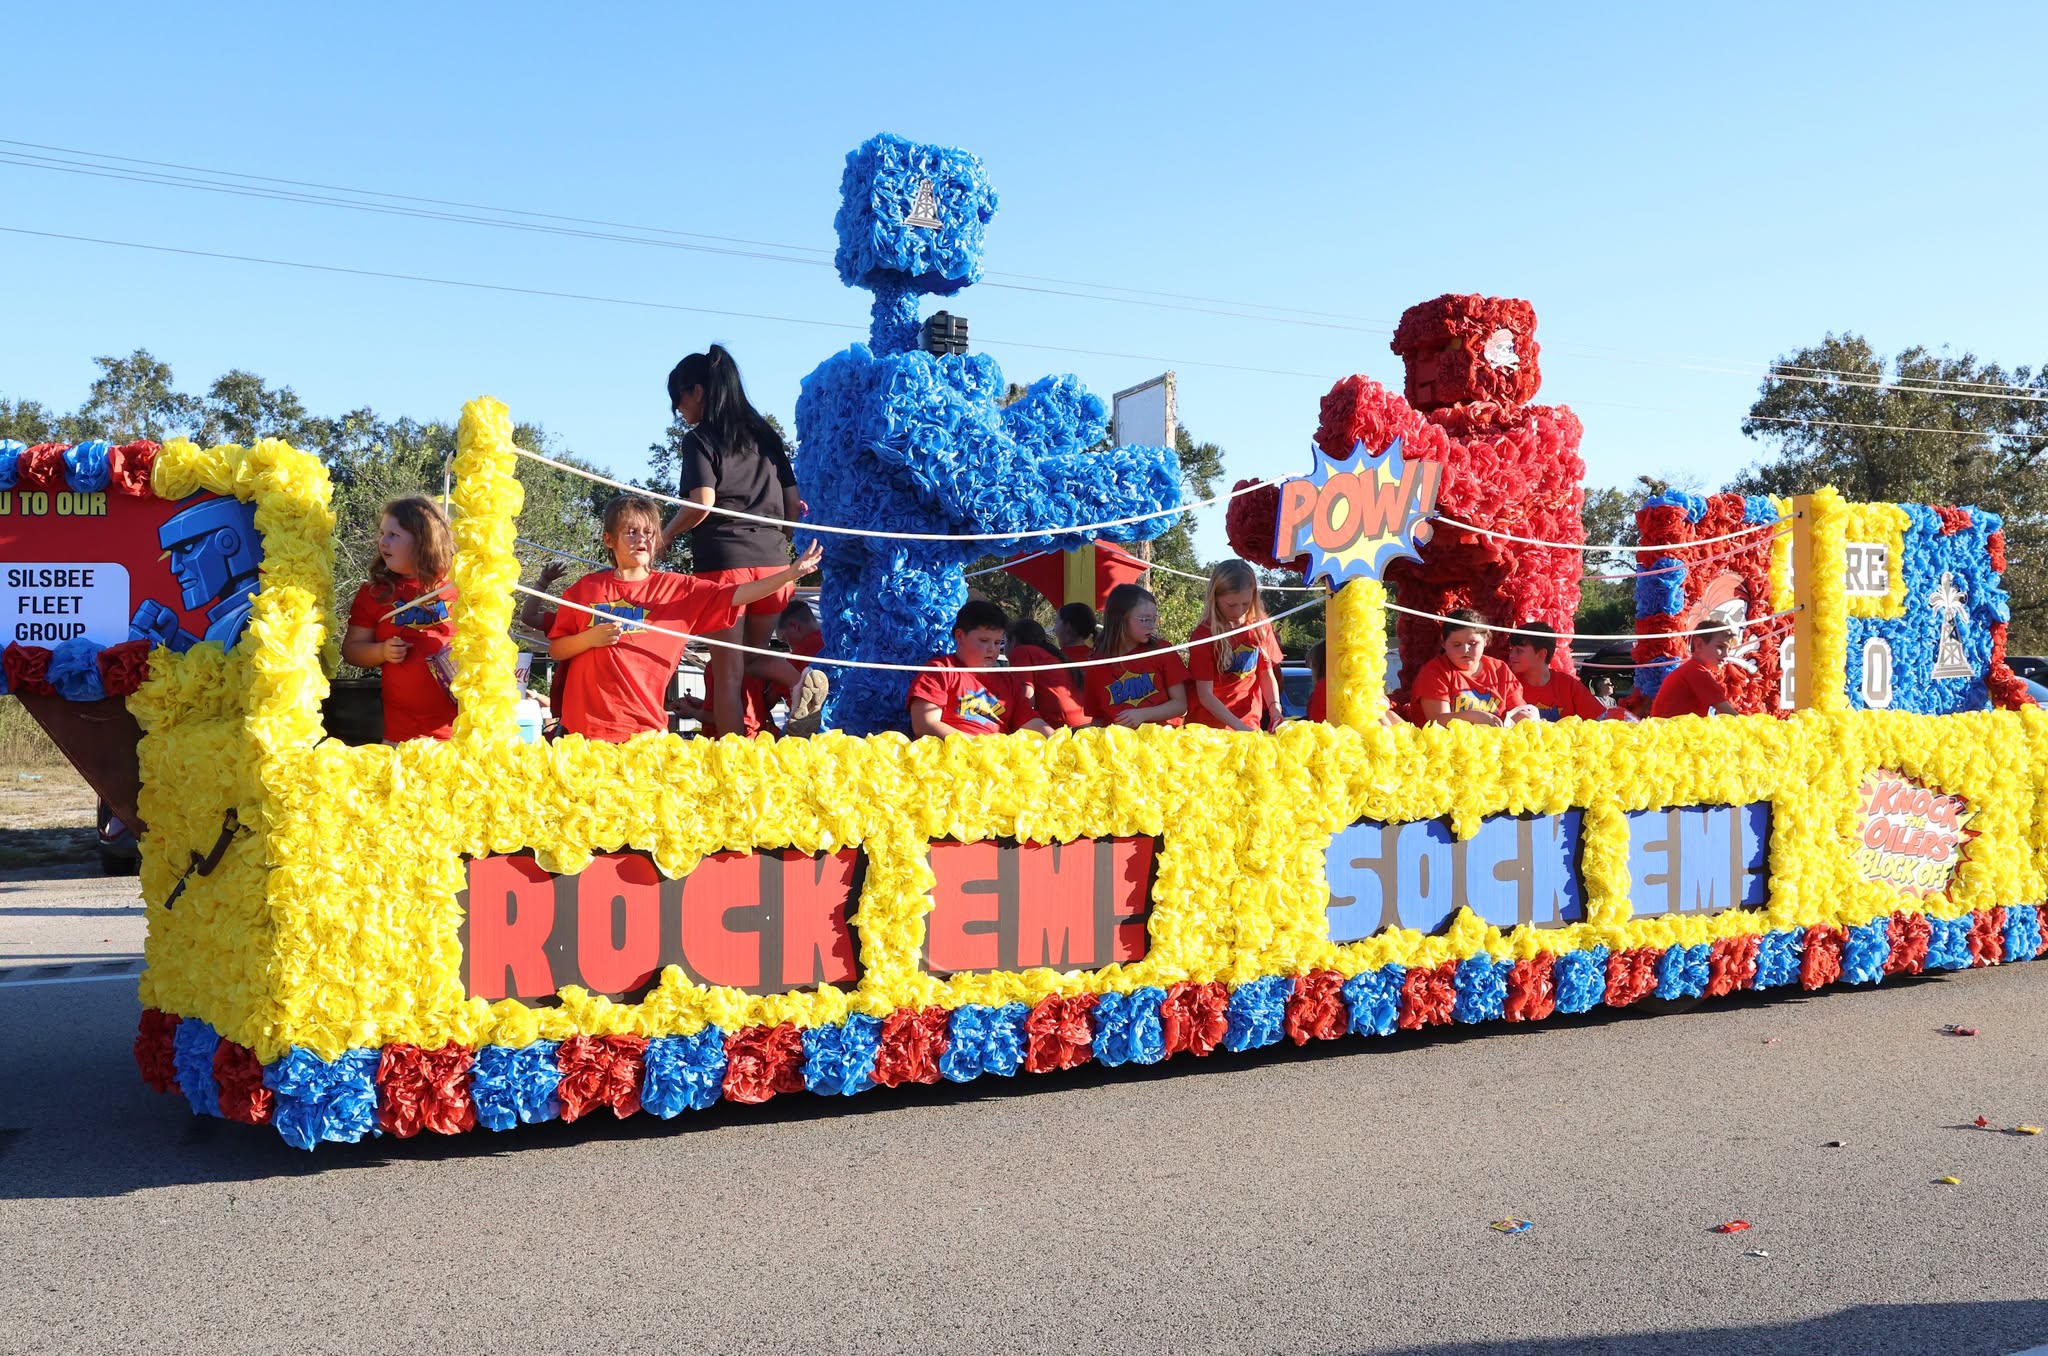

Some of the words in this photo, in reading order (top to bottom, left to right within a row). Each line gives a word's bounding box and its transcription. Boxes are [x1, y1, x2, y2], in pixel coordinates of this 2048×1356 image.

[19, 491, 48, 515] TO
[57, 491, 107, 515] OUR
[1276, 459, 1441, 559] POW!
[8, 569, 94, 587] SILSBEE
[19, 596, 83, 614] FLEET
[15, 623, 86, 641] GROUP
[1110, 672, 1155, 705] BAM
[1868, 780, 1967, 832] KNOCK
[1905, 815, 1928, 829] THE
[1325, 811, 1582, 942] SOCK
[1625, 801, 1771, 915] EM!
[1861, 847, 1919, 885] BLOCK
[1917, 861, 1955, 889] OFF
[469, 848, 858, 1000] ROCK
[929, 837, 1154, 971] EM!
